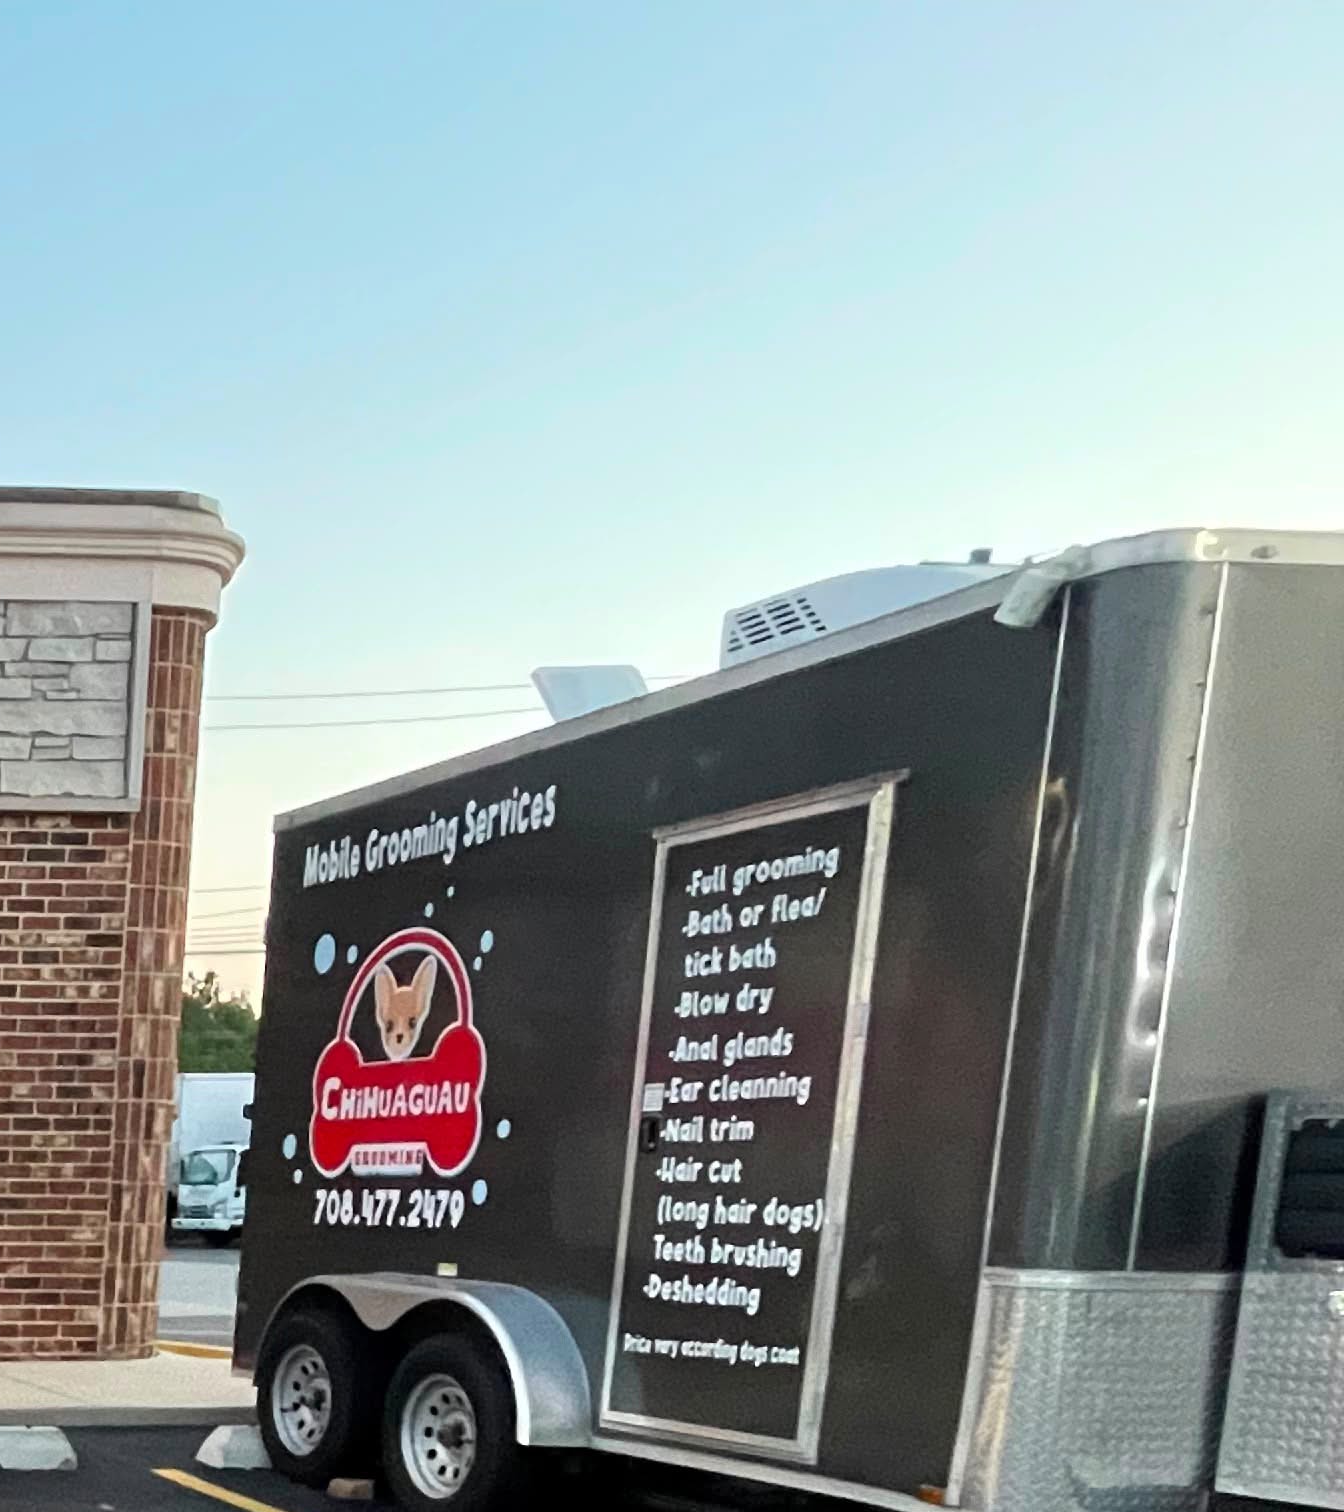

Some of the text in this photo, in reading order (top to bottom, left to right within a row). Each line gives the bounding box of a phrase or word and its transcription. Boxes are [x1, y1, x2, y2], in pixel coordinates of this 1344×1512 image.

[303, 784, 558, 888] Mobile Grooming Services
[732, 847, 841, 896] grooming
[739, 904, 765, 928] or
[771, 887, 828, 924] flea/
[684, 937, 777, 978] tick bath
[736, 982, 776, 1015] dry
[722, 1027, 794, 1067] glands
[708, 1070, 812, 1106] cleanning
[709, 1114, 756, 1142] trim
[354, 1148, 424, 1166] GROOMING
[708, 1157, 744, 1184] cut
[313, 1188, 465, 1229] 708.477.2479
[657, 1194, 825, 1235] (long hair dogs)
[653, 1234, 803, 1278] Teeth brushing
